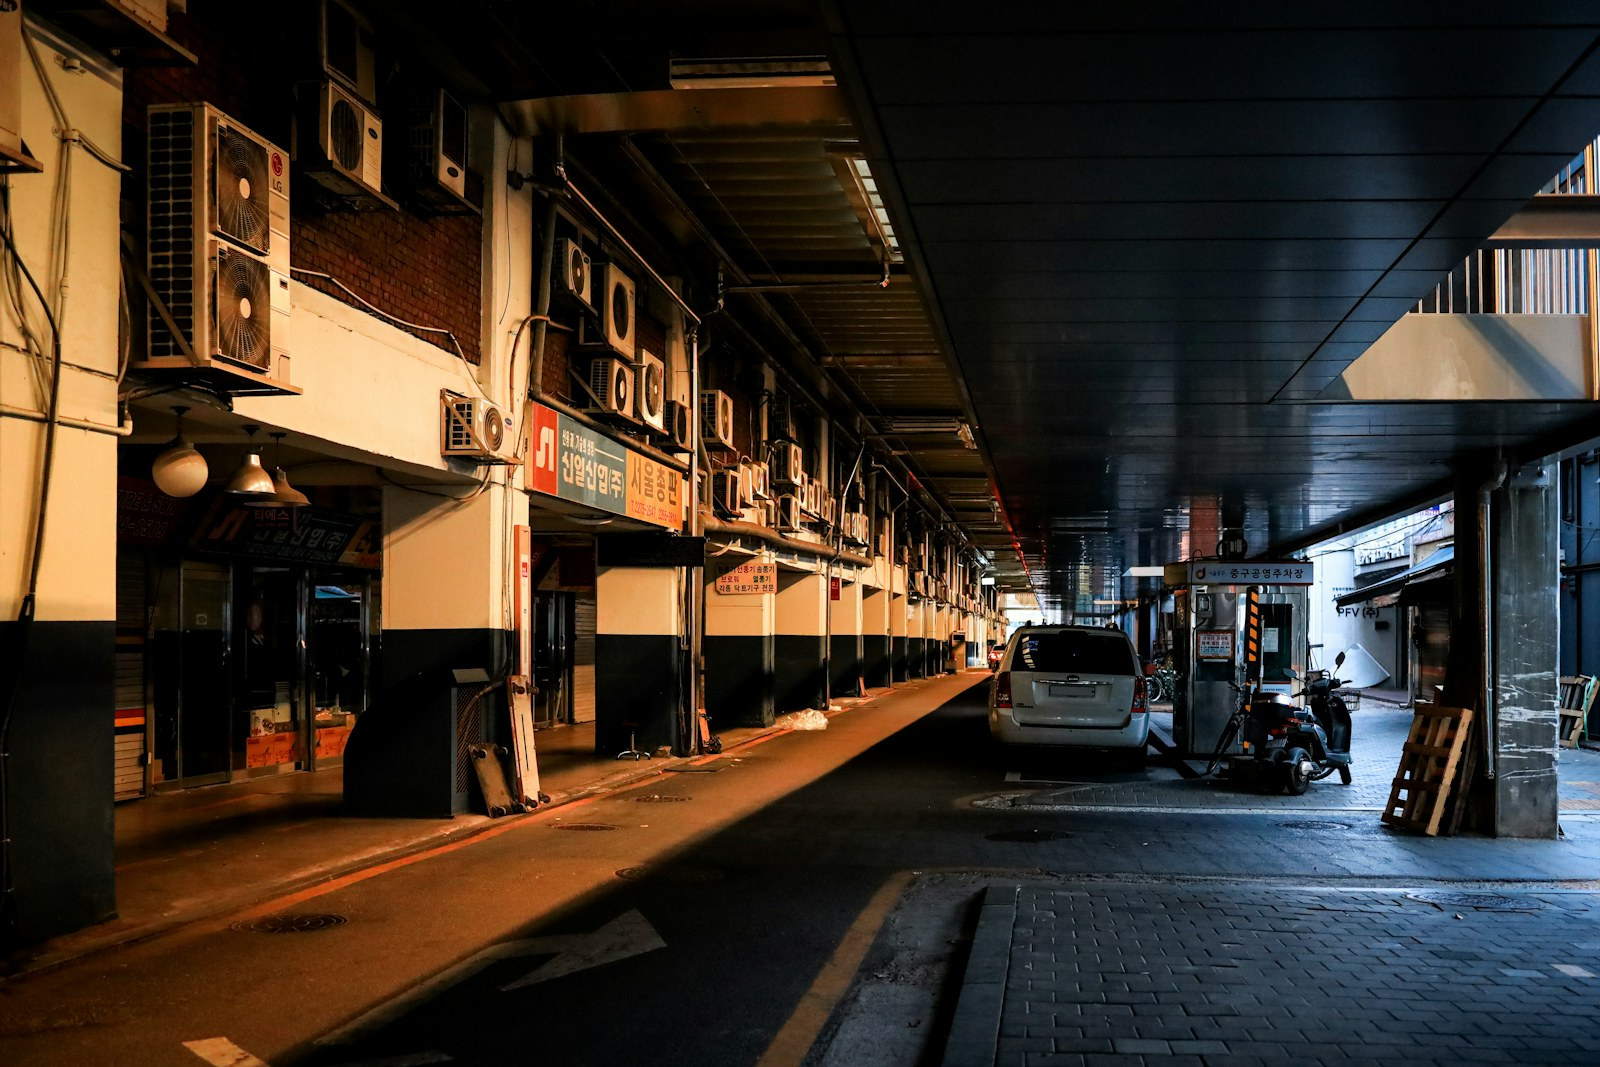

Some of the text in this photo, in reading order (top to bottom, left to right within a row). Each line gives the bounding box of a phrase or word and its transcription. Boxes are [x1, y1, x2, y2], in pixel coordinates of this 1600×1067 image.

[562, 451, 624, 499] 신일산업(주)
[631, 455, 677, 506] 서울총판
[1230, 568, 1304, 579] 중구공영주차장
[1338, 607, 1379, 619] PFV (주)
